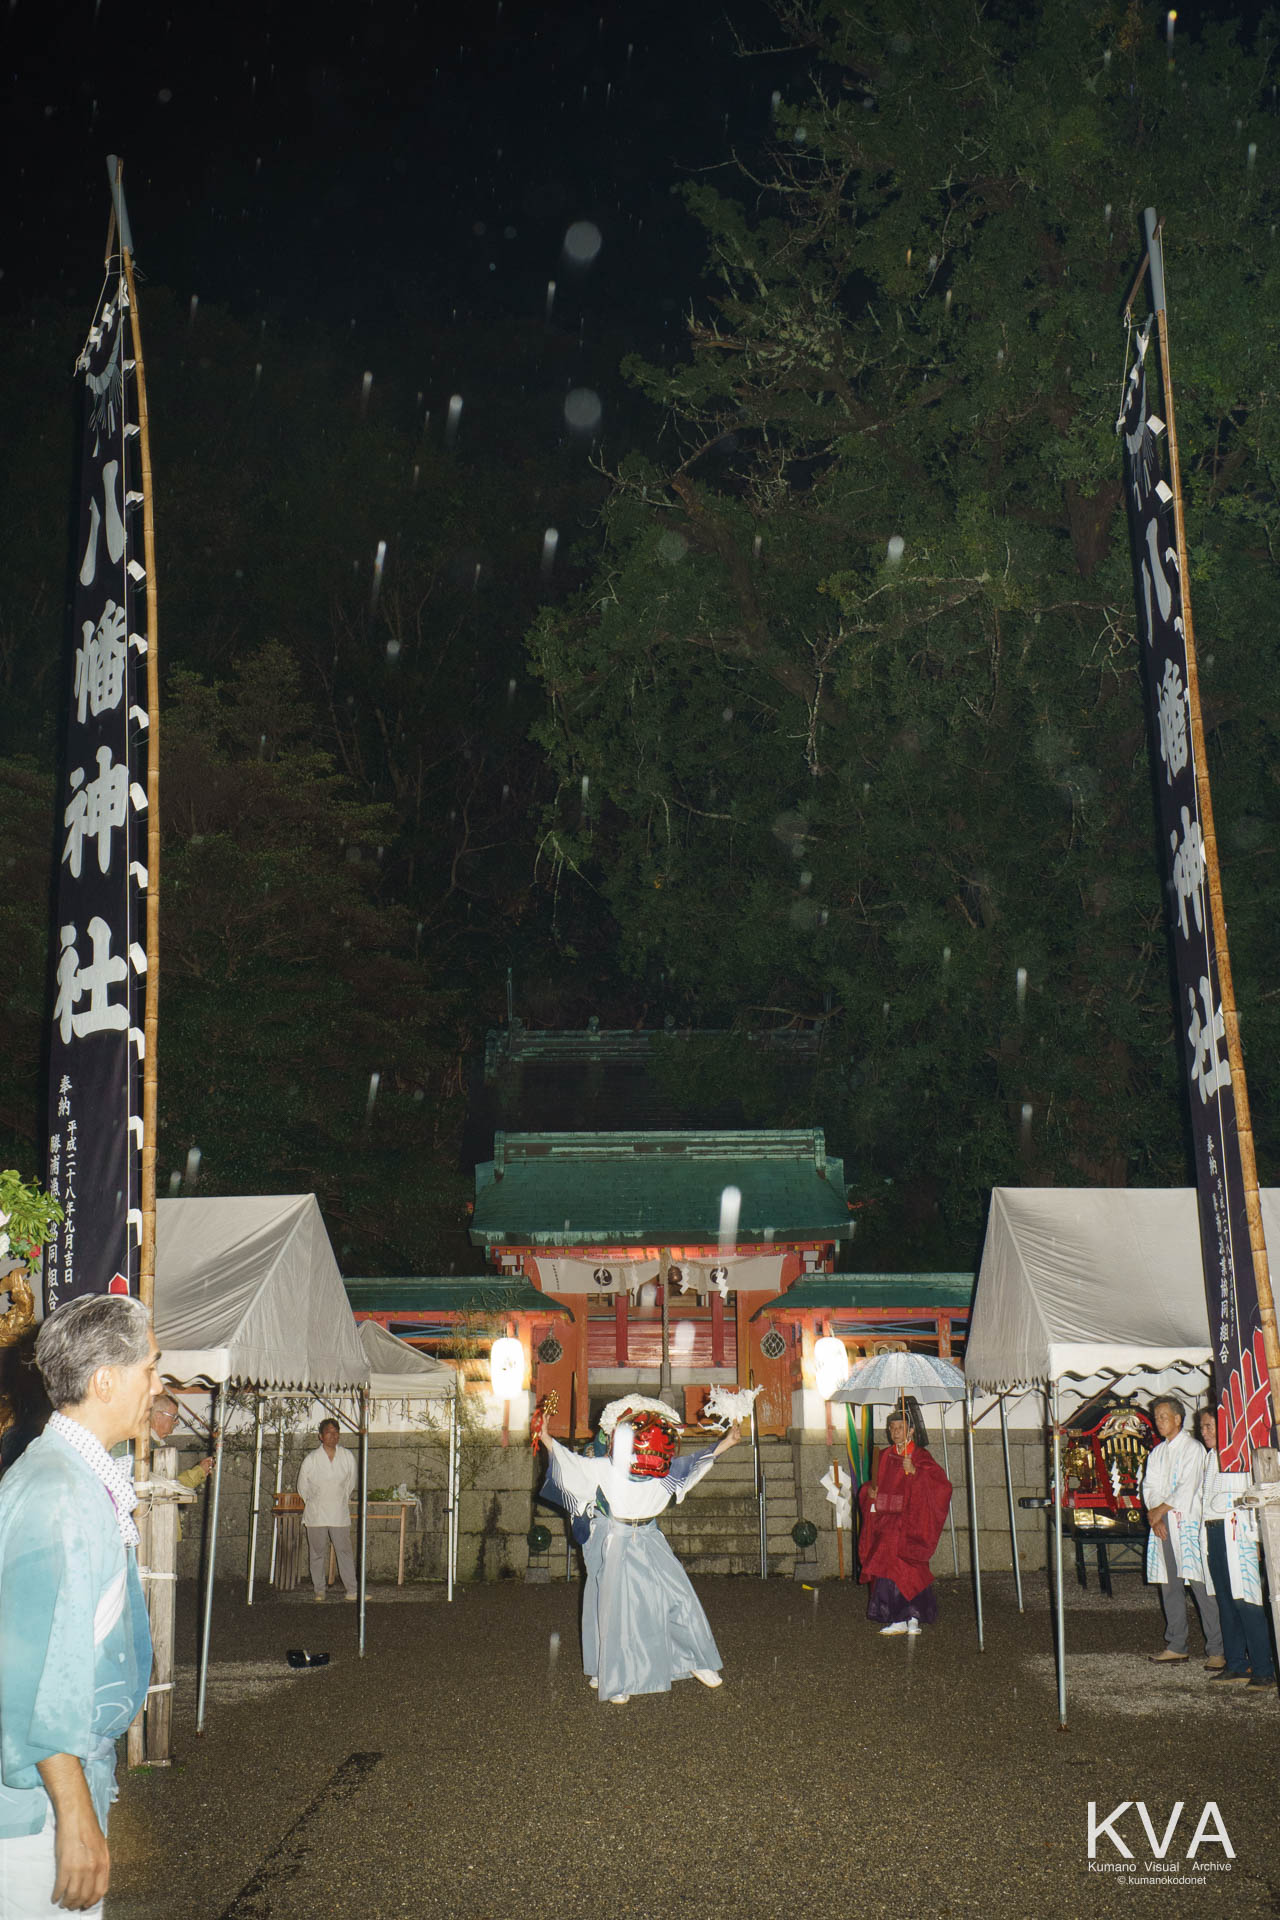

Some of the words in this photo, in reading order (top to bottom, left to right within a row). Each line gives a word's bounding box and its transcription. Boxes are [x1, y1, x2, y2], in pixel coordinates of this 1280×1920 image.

[53, 459, 130, 1046] 八幡神社
[1141, 517, 1232, 1105] 八幡神社
[57, 1074, 73, 1118] 奉納
[47, 1133, 62, 1311] 勝浦漁協同組合
[64, 1120, 78, 1284] 平成二十八年九月吉日
